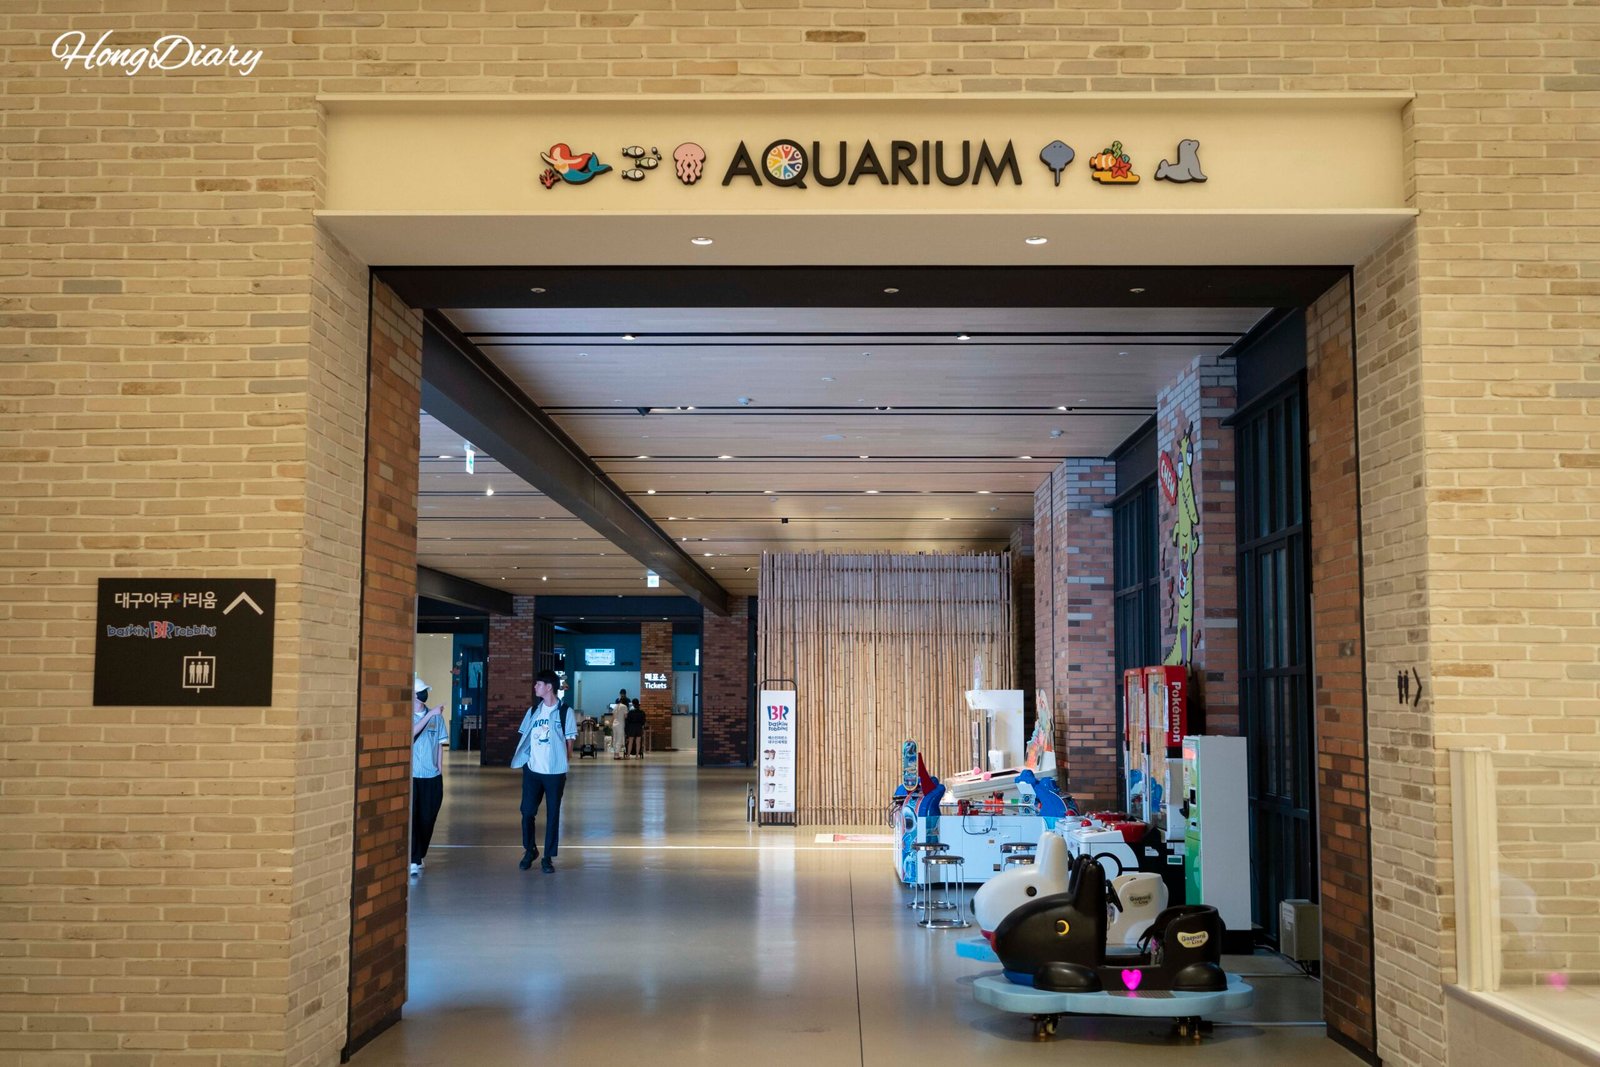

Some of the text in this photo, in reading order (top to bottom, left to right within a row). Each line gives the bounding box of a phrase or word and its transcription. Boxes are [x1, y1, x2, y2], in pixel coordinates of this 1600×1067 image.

[721, 139, 1022, 190] AQUARIUM
[115, 591, 218, 609] 대구아쿠아리움
[107, 624, 150, 638] baskin
[174, 624, 217, 637] robbins
[644, 673, 667, 681] 매표소
[1171, 681, 1182, 742] Pokémon
